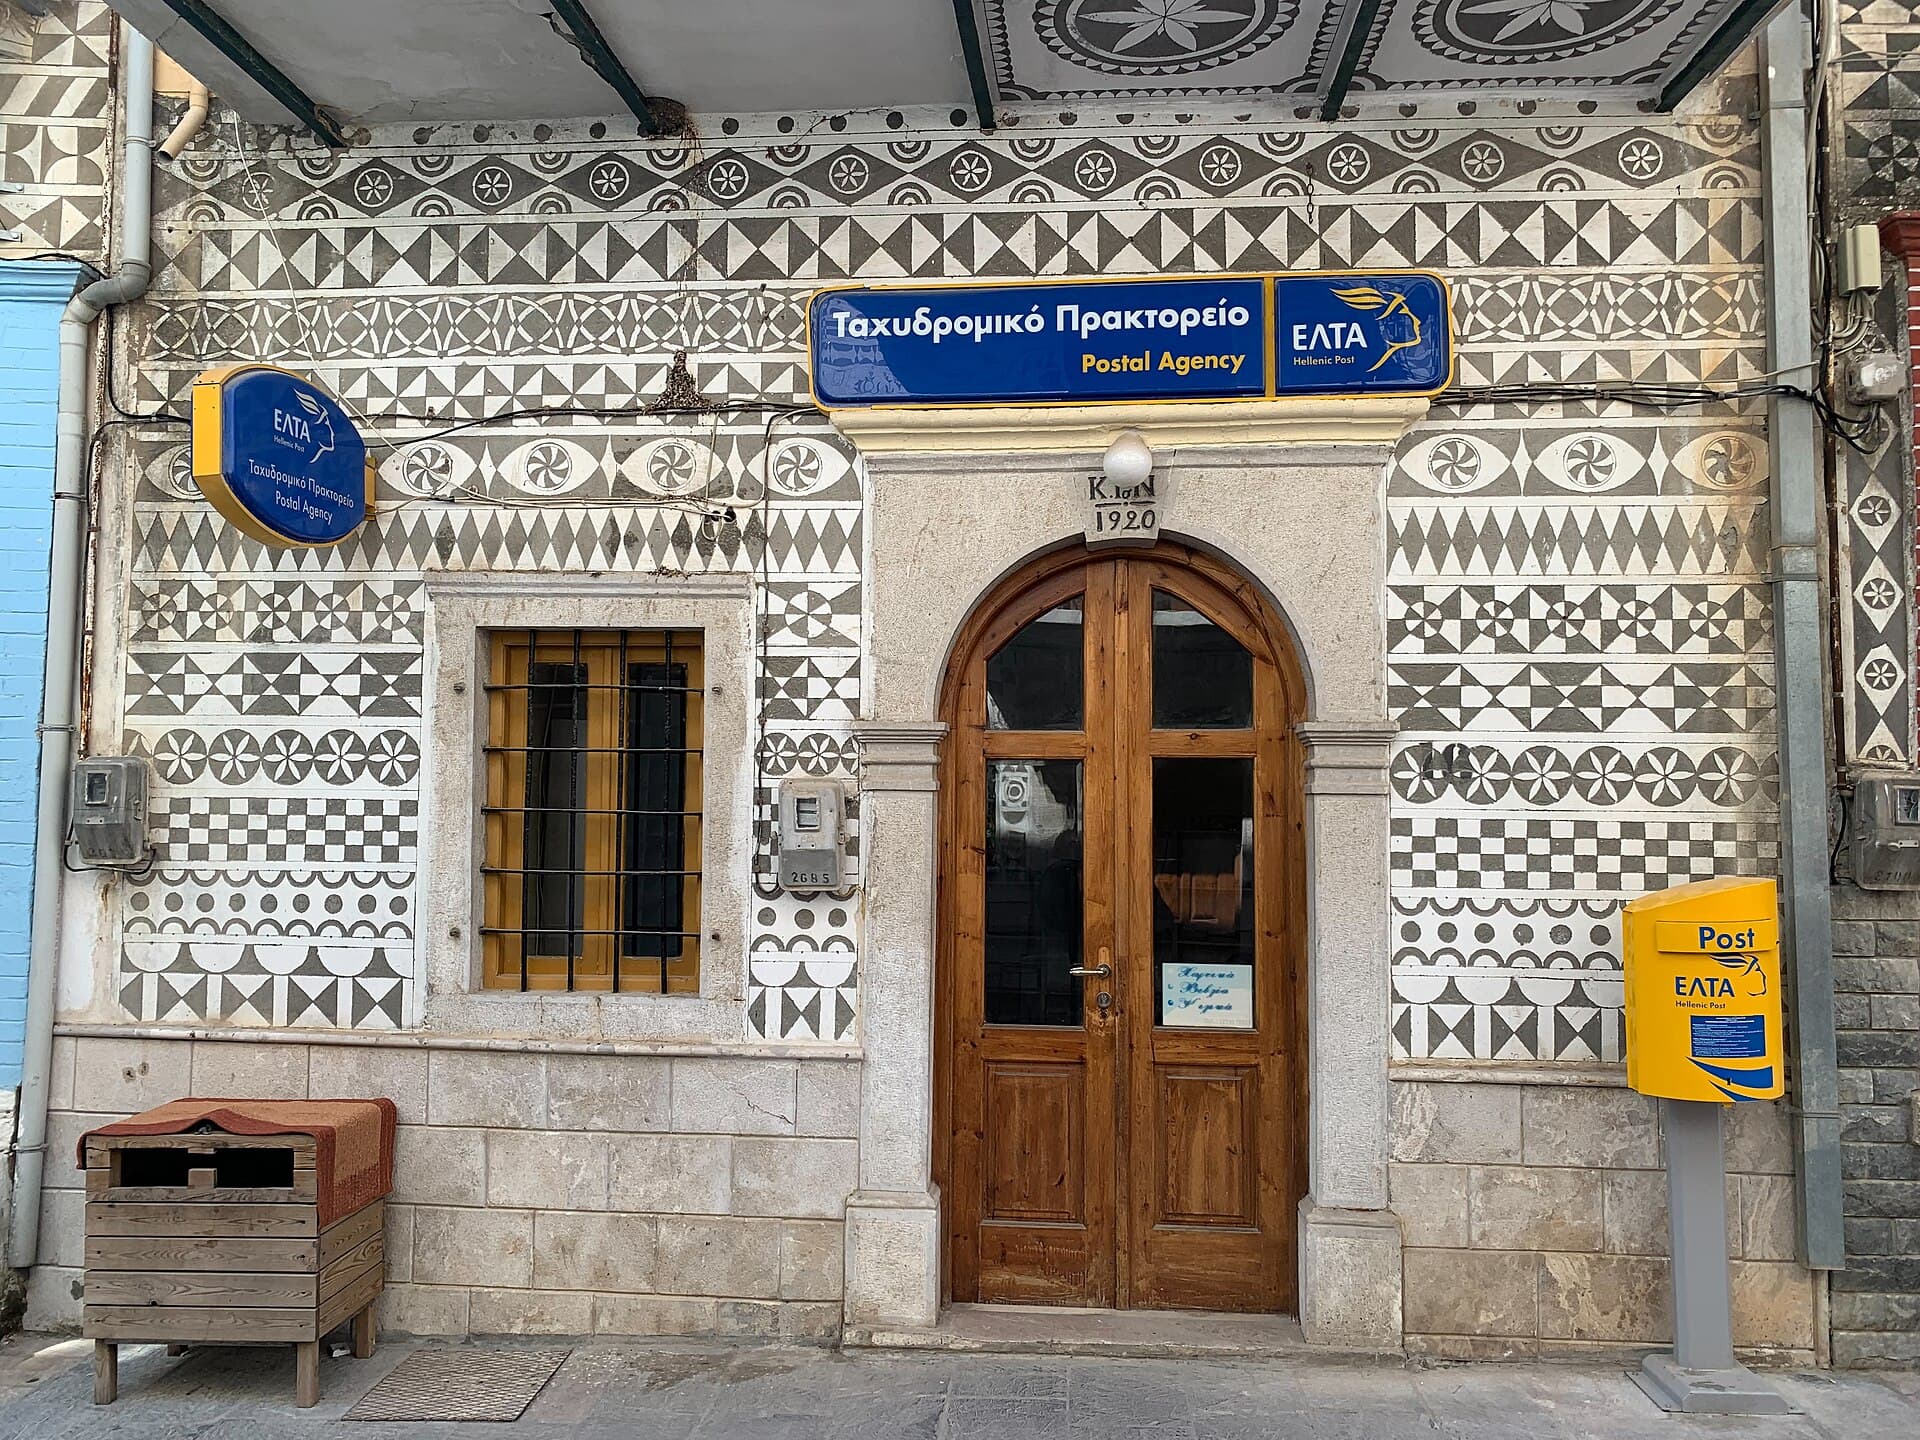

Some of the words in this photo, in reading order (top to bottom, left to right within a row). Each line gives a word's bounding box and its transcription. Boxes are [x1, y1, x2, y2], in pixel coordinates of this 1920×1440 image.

[832, 304, 1045, 344] Ταχυδρομικό
[1056, 297, 1250, 339] Πρακτορείο
[1292, 322, 1368, 351] ΕΛΤΑ
[1081, 350, 1150, 374] Postal
[1157, 351, 1246, 376] Agency
[1293, 356, 1332, 366] Hellenic
[1335, 355, 1355, 365] Post
[273, 408, 311, 444] ΕΛΤΑ
[273, 434, 294, 449] Hellenic
[248, 458, 306, 489] Ταχυδρομικό
[308, 478, 354, 509] Πρακτορείο
[275, 490, 301, 512] Postal
[302, 500, 333, 526] Agency
[1096, 509, 1156, 532] 1920
[1698, 926, 1755, 949] Post
[1674, 976, 1735, 998] ΕΛΤΑ
[1675, 1000, 1708, 1009] Hellenic
[1709, 1001, 1726, 1009] Post
